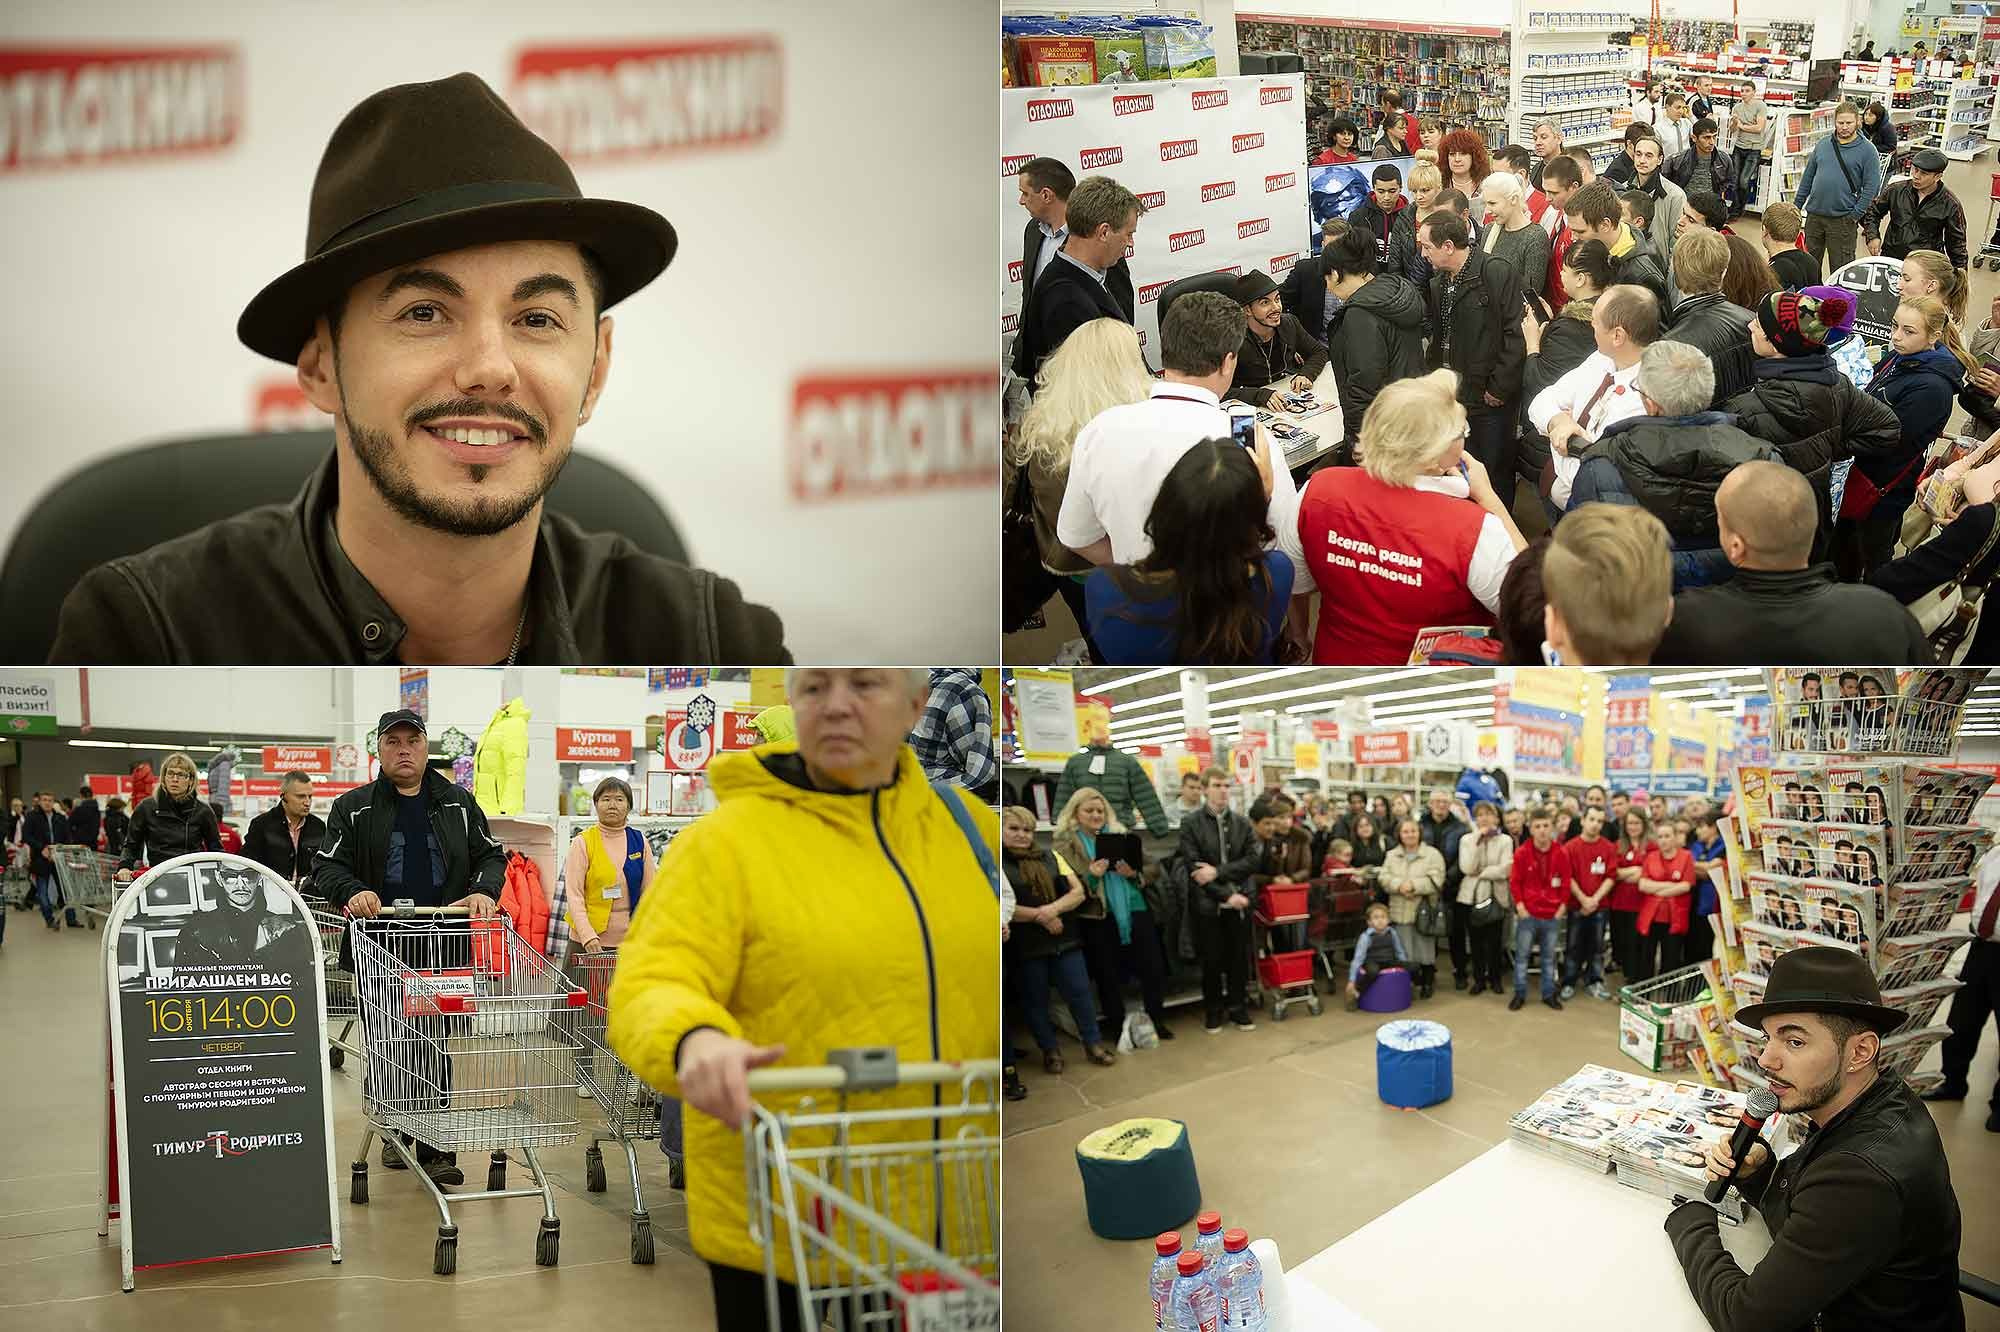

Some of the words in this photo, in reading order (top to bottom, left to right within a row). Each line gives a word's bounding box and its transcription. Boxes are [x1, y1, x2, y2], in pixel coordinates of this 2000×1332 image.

[1114, 96, 1153, 115] ОТДОХНИ!
[1193, 92, 1228, 110] ОТДОХНИ!
[1260, 88, 1292, 105] ОТДОХНИ!
[0, 60, 240, 165] ТДОХНИ!
[1029, 101, 1073, 121] ОТДОХНИ!
[1161, 140, 1197, 161] ОТДОХНИ!
[1232, 134, 1264, 153] ОТДОХНИ!
[1082, 148, 1122, 169] ОТДОХНИ!
[1202, 182, 1235, 202] ОТДОХНИ!
[1265, 173, 1295, 192] ОТДОХНИ!
[1142, 192, 1166, 209] ОХНИ!
[1238, 219, 1269, 239] ОТДОХНИ!
[1170, 230, 1205, 252] ОТДОХНИ!
[1852, 322, 1891, 339] ЛАШАЕМ
[1328, 529, 1376, 556] Всегда
[1379, 549, 1422, 569] рады
[1327, 552, 1357, 568] вам
[1359, 561, 1422, 587] помочь!
[0, 685, 48, 697] пасибо
[572, 730, 616, 745] Куртки
[277, 747, 317, 761] Куртки
[567, 745, 620, 757] женские
[145, 974, 257, 990] ПРИГЛАШАЕМ
[261, 973, 292, 986] ВАС
[145, 998, 184, 1033] 16
[185, 999, 193, 1032] ОКТЯБРЯ
[195, 994, 296, 1030] 14:00
[201, 1042, 246, 1053] ЧЕТВЕРГ
[197, 1066, 224, 1075] ОТДЕЛ
[225, 1064, 252, 1073] КНИГИ
[151, 1091, 212, 1102] ПОПУЛЯРНЫМ
[213, 1089, 247, 1099] ПЕВЦОМ
[249, 1088, 256, 1096] И
[256, 1085, 306, 1096] ШОУ-МЕНОМ
[163, 1082, 208, 1092] АВТОГРАФ
[208, 1080, 242, 1089] СЕССИЯ
[243, 1079, 250, 1087] И
[251, 1077, 287, 1086] ВСТРЕЧА
[177, 1100, 218, 1111] ТИМУРОМ
[220, 1097, 276, 1108] РОДРИГЕЗОМ!
[152, 1140, 206, 1156] ТИМУР
[230, 1133, 303, 1151] РОДРИГЕЗ
